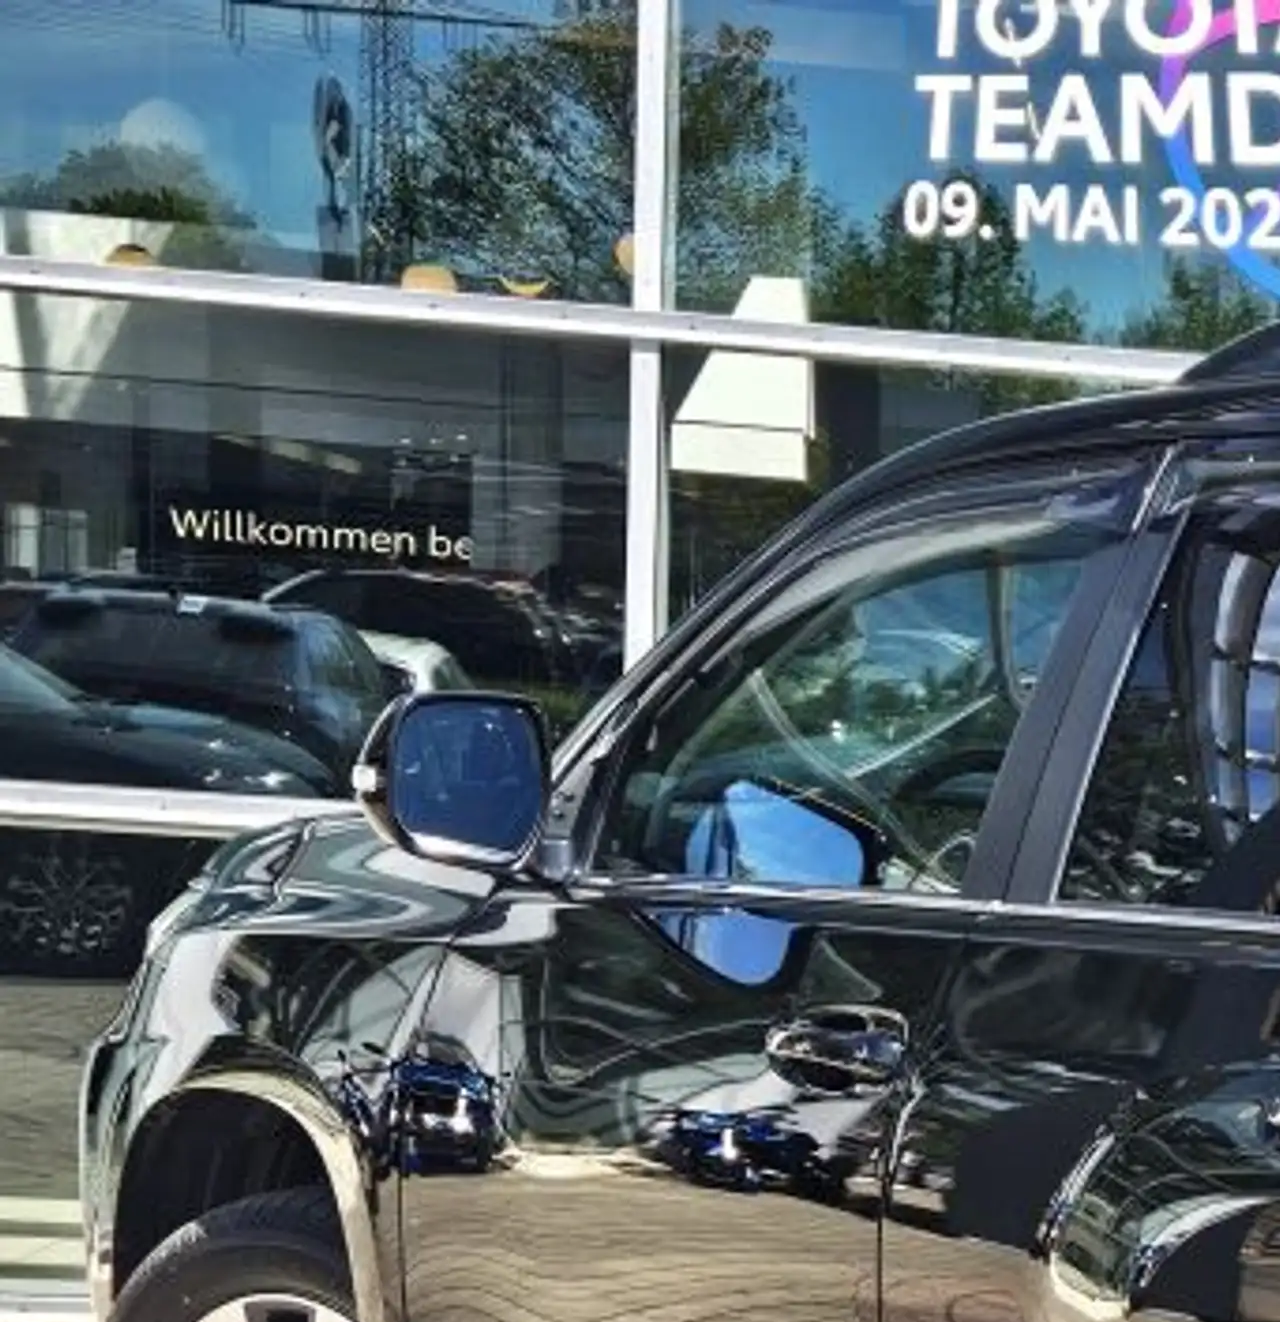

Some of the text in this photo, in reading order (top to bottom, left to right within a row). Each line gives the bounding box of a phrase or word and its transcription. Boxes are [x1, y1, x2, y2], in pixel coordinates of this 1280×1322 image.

[903, 180, 993, 239] 09.
[1015, 183, 1140, 246] MAI
[169, 504, 417, 557] Willkommen
